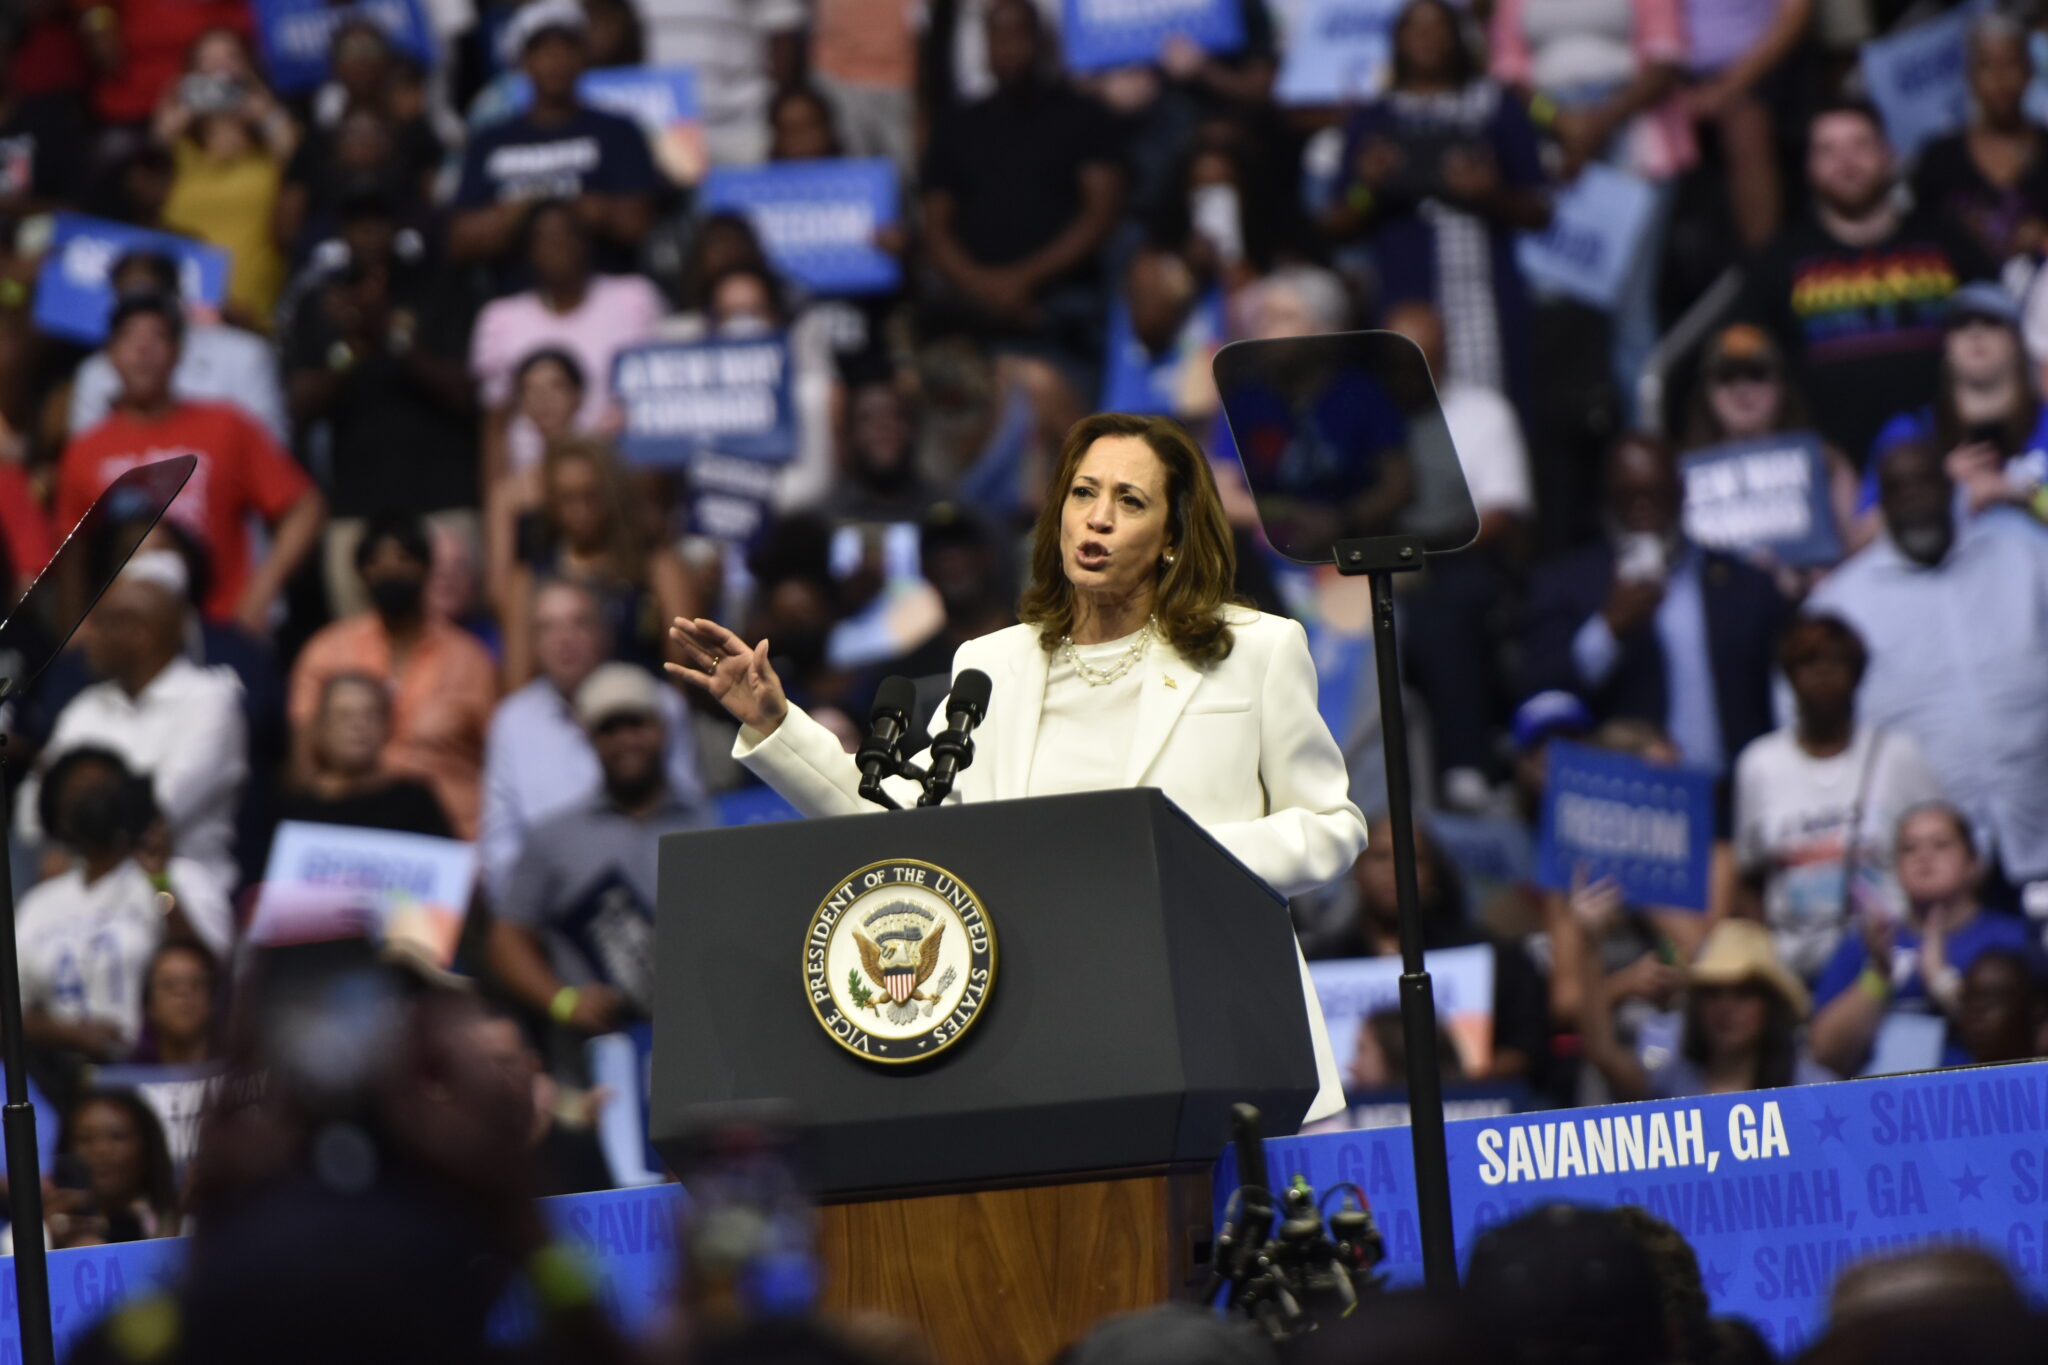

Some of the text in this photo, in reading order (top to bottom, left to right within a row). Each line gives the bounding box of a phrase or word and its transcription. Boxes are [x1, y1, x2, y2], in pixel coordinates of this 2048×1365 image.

[1556, 791, 1690, 861] FREEDOM
[808, 867, 989, 1053] VICE PRESIDENT OF THE UNITED STATES
[1476, 1100, 1791, 1186] SAVANNAH, GA
[1869, 1074, 2048, 1147] SAVANN
[1337, 1140, 1397, 1198] GA
[1866, 1160, 1929, 1219] GA
[73, 1255, 128, 1314] GA
